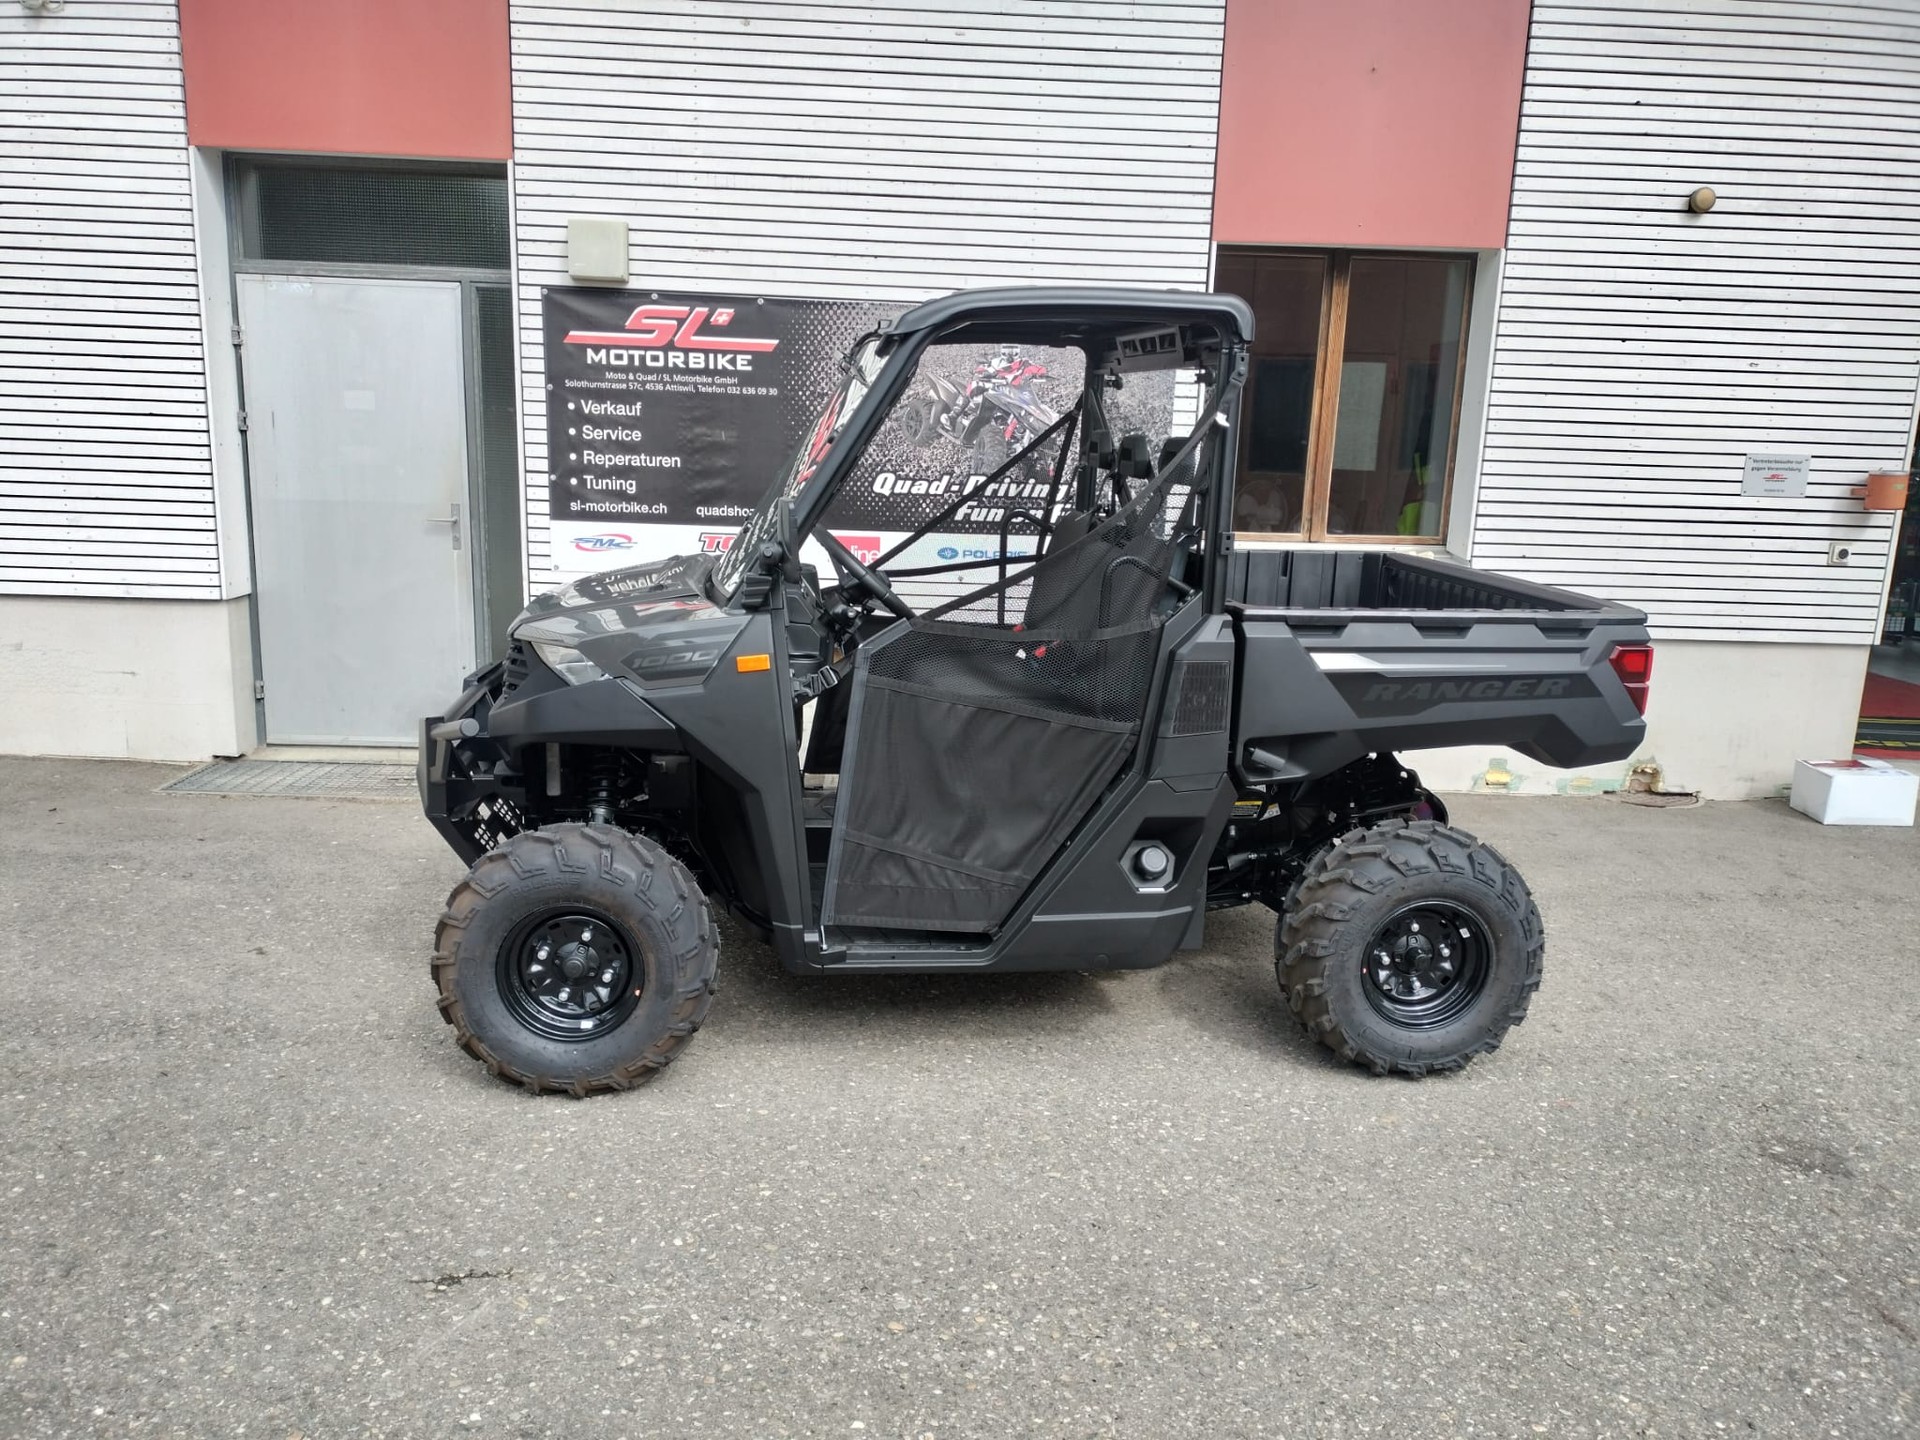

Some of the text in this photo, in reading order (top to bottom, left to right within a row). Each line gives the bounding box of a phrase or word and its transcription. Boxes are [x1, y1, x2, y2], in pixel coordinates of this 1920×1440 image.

[586, 348, 752, 371] MOTORBIKE
[605, 371, 626, 380] Moto
[628, 372, 634, 380] &
[635, 372, 657, 381] Quad
[662, 373, 671, 382] SL
[673, 374, 712, 383] Motorbike
[714, 376, 738, 384] GmbH
[564, 379, 778, 396] Solothurnstrasse 57c, 4536 Attiswil, Telefon 032 636 09 30
[580, 399, 642, 416] Verkauf
[582, 425, 642, 441] Service
[583, 450, 681, 468] Reperaturen
[583, 475, 637, 494] Tuning
[570, 500, 668, 514] sl-motorbike.ch
[696, 505, 754, 518] quadsho
[954, 501, 1005, 522] Fun
[631, 649, 719, 669] 1000
[1362, 678, 1571, 701] RANGER
